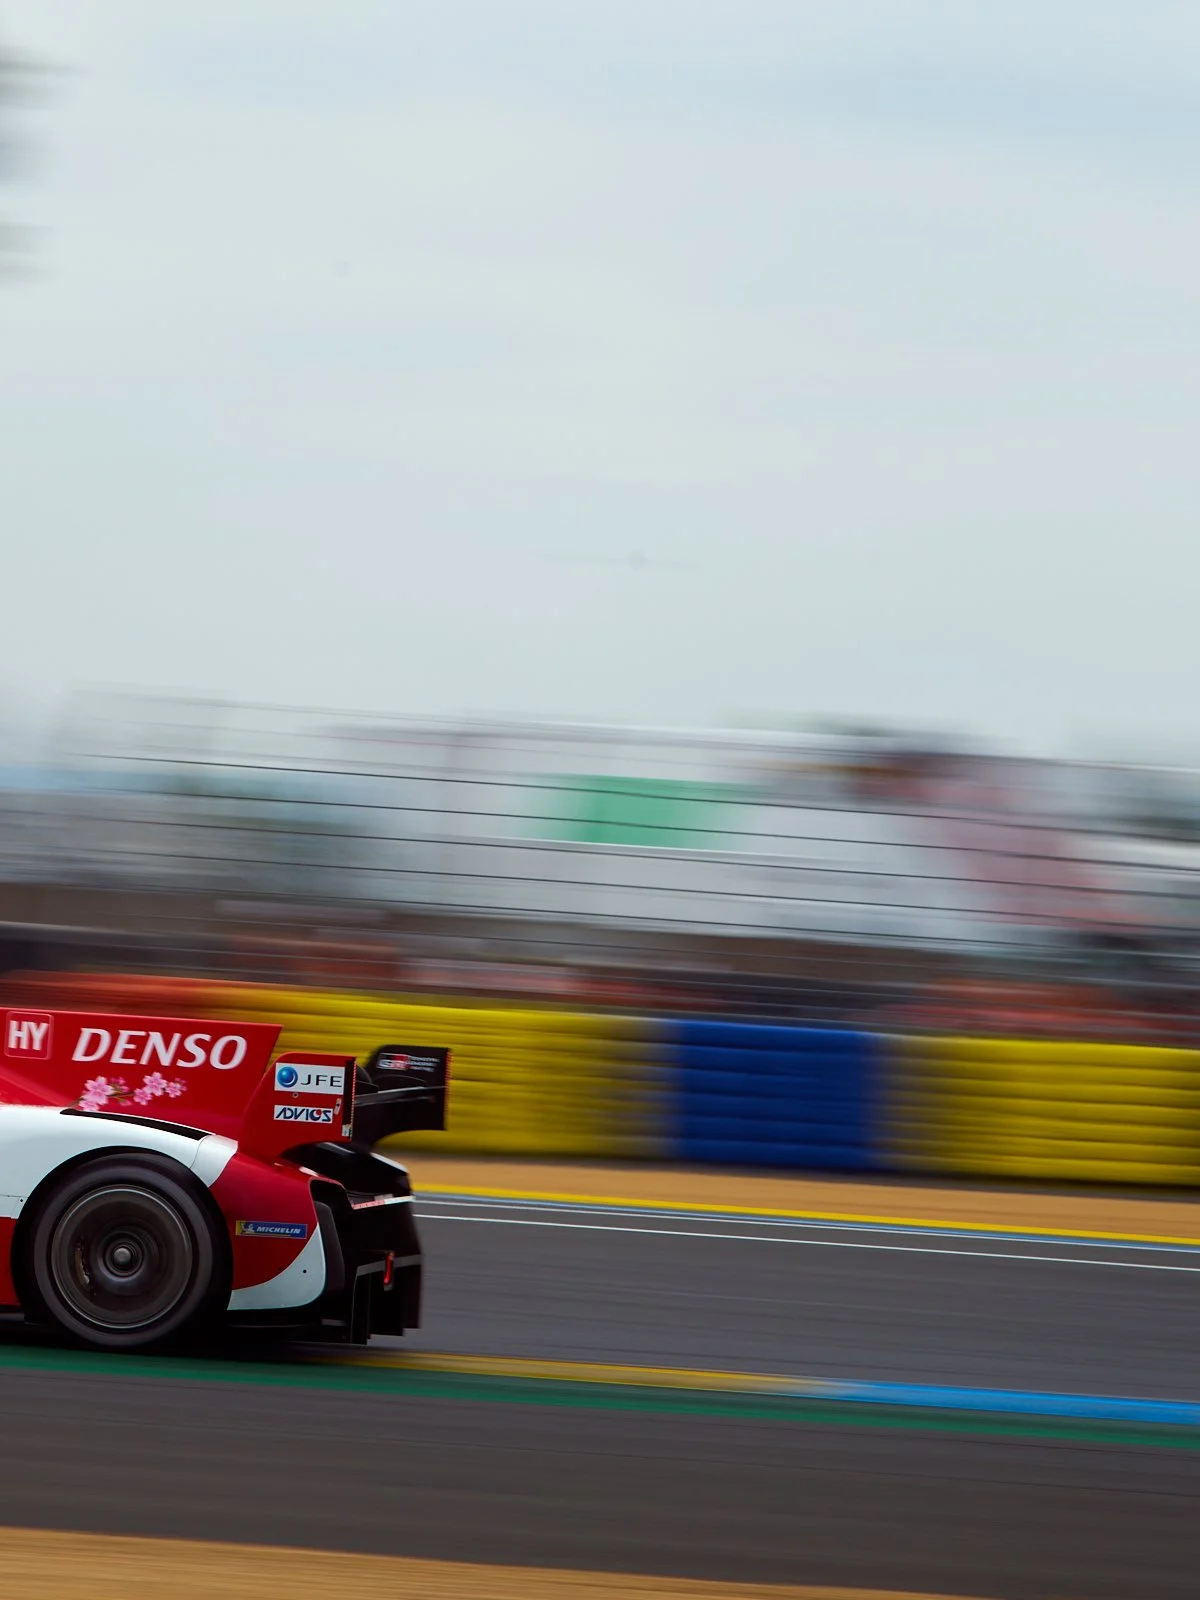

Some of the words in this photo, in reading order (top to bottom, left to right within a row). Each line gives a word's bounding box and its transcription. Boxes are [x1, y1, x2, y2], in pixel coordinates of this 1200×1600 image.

[7, 1020, 49, 1051] HY
[71, 1027, 248, 1070] DENSO
[300, 1074, 343, 1088] JFE
[275, 1107, 331, 1122] ADVICS
[256, 1226, 301, 1234] MICHELIN
